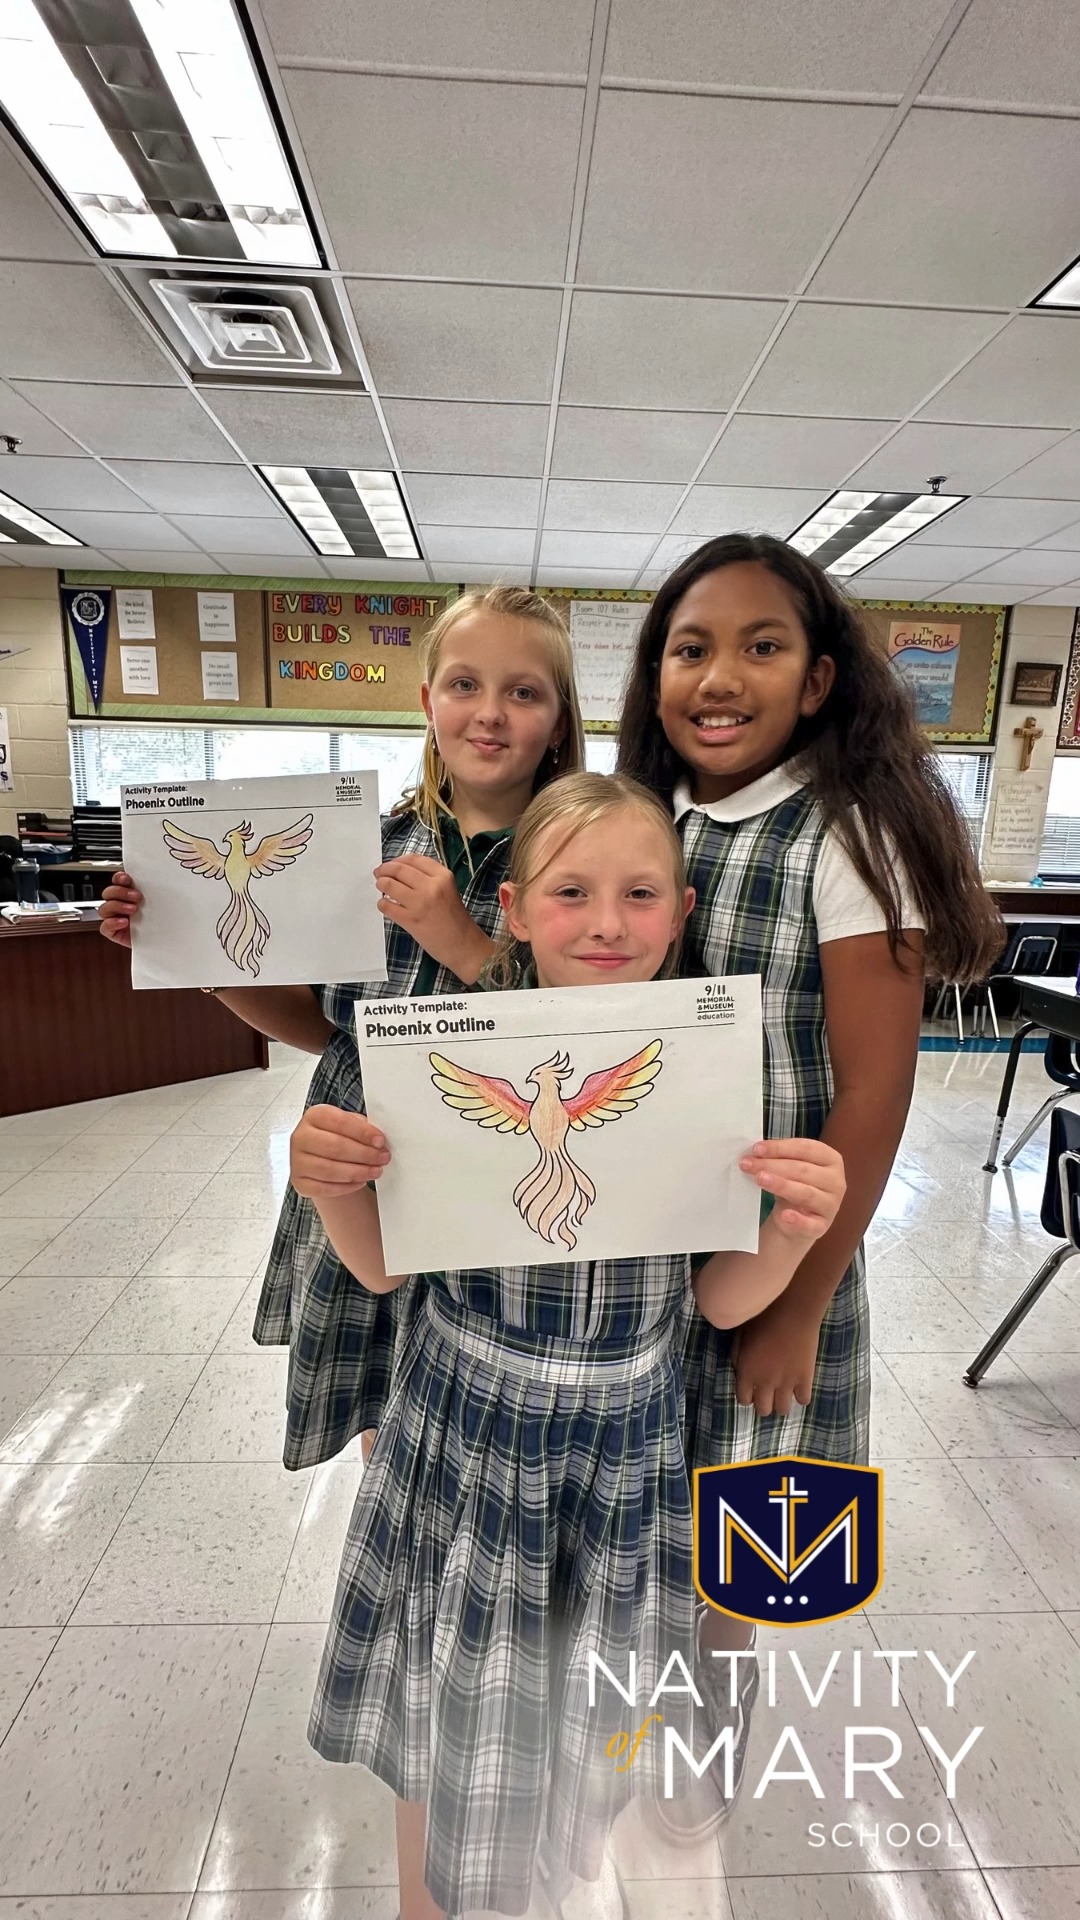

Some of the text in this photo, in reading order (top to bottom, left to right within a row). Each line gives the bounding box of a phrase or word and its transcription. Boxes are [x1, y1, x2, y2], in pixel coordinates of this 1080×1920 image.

[272, 593, 438, 617] EVERY KNIGHT
[576, 604, 630, 613] Room 107 Rules
[578, 619, 602, 628] Respect
[272, 623, 411, 646] BUILDS THE
[921, 627, 934, 635] The
[894, 632, 954, 648] Golden Rule
[279, 660, 386, 683] KINGDOM
[930, 662, 952, 670] others
[340, 776, 355, 785] 9/11
[125, 785, 188, 795] Activity Template:
[126, 796, 205, 810] Phoenix Outline
[704, 984, 726, 996] 9/11
[697, 996, 735, 1004] MEMORIAL
[364, 1001, 468, 1016] Activity Template:
[698, 1012, 735, 1020] education
[366, 1017, 496, 1038] Phoenix Outline
